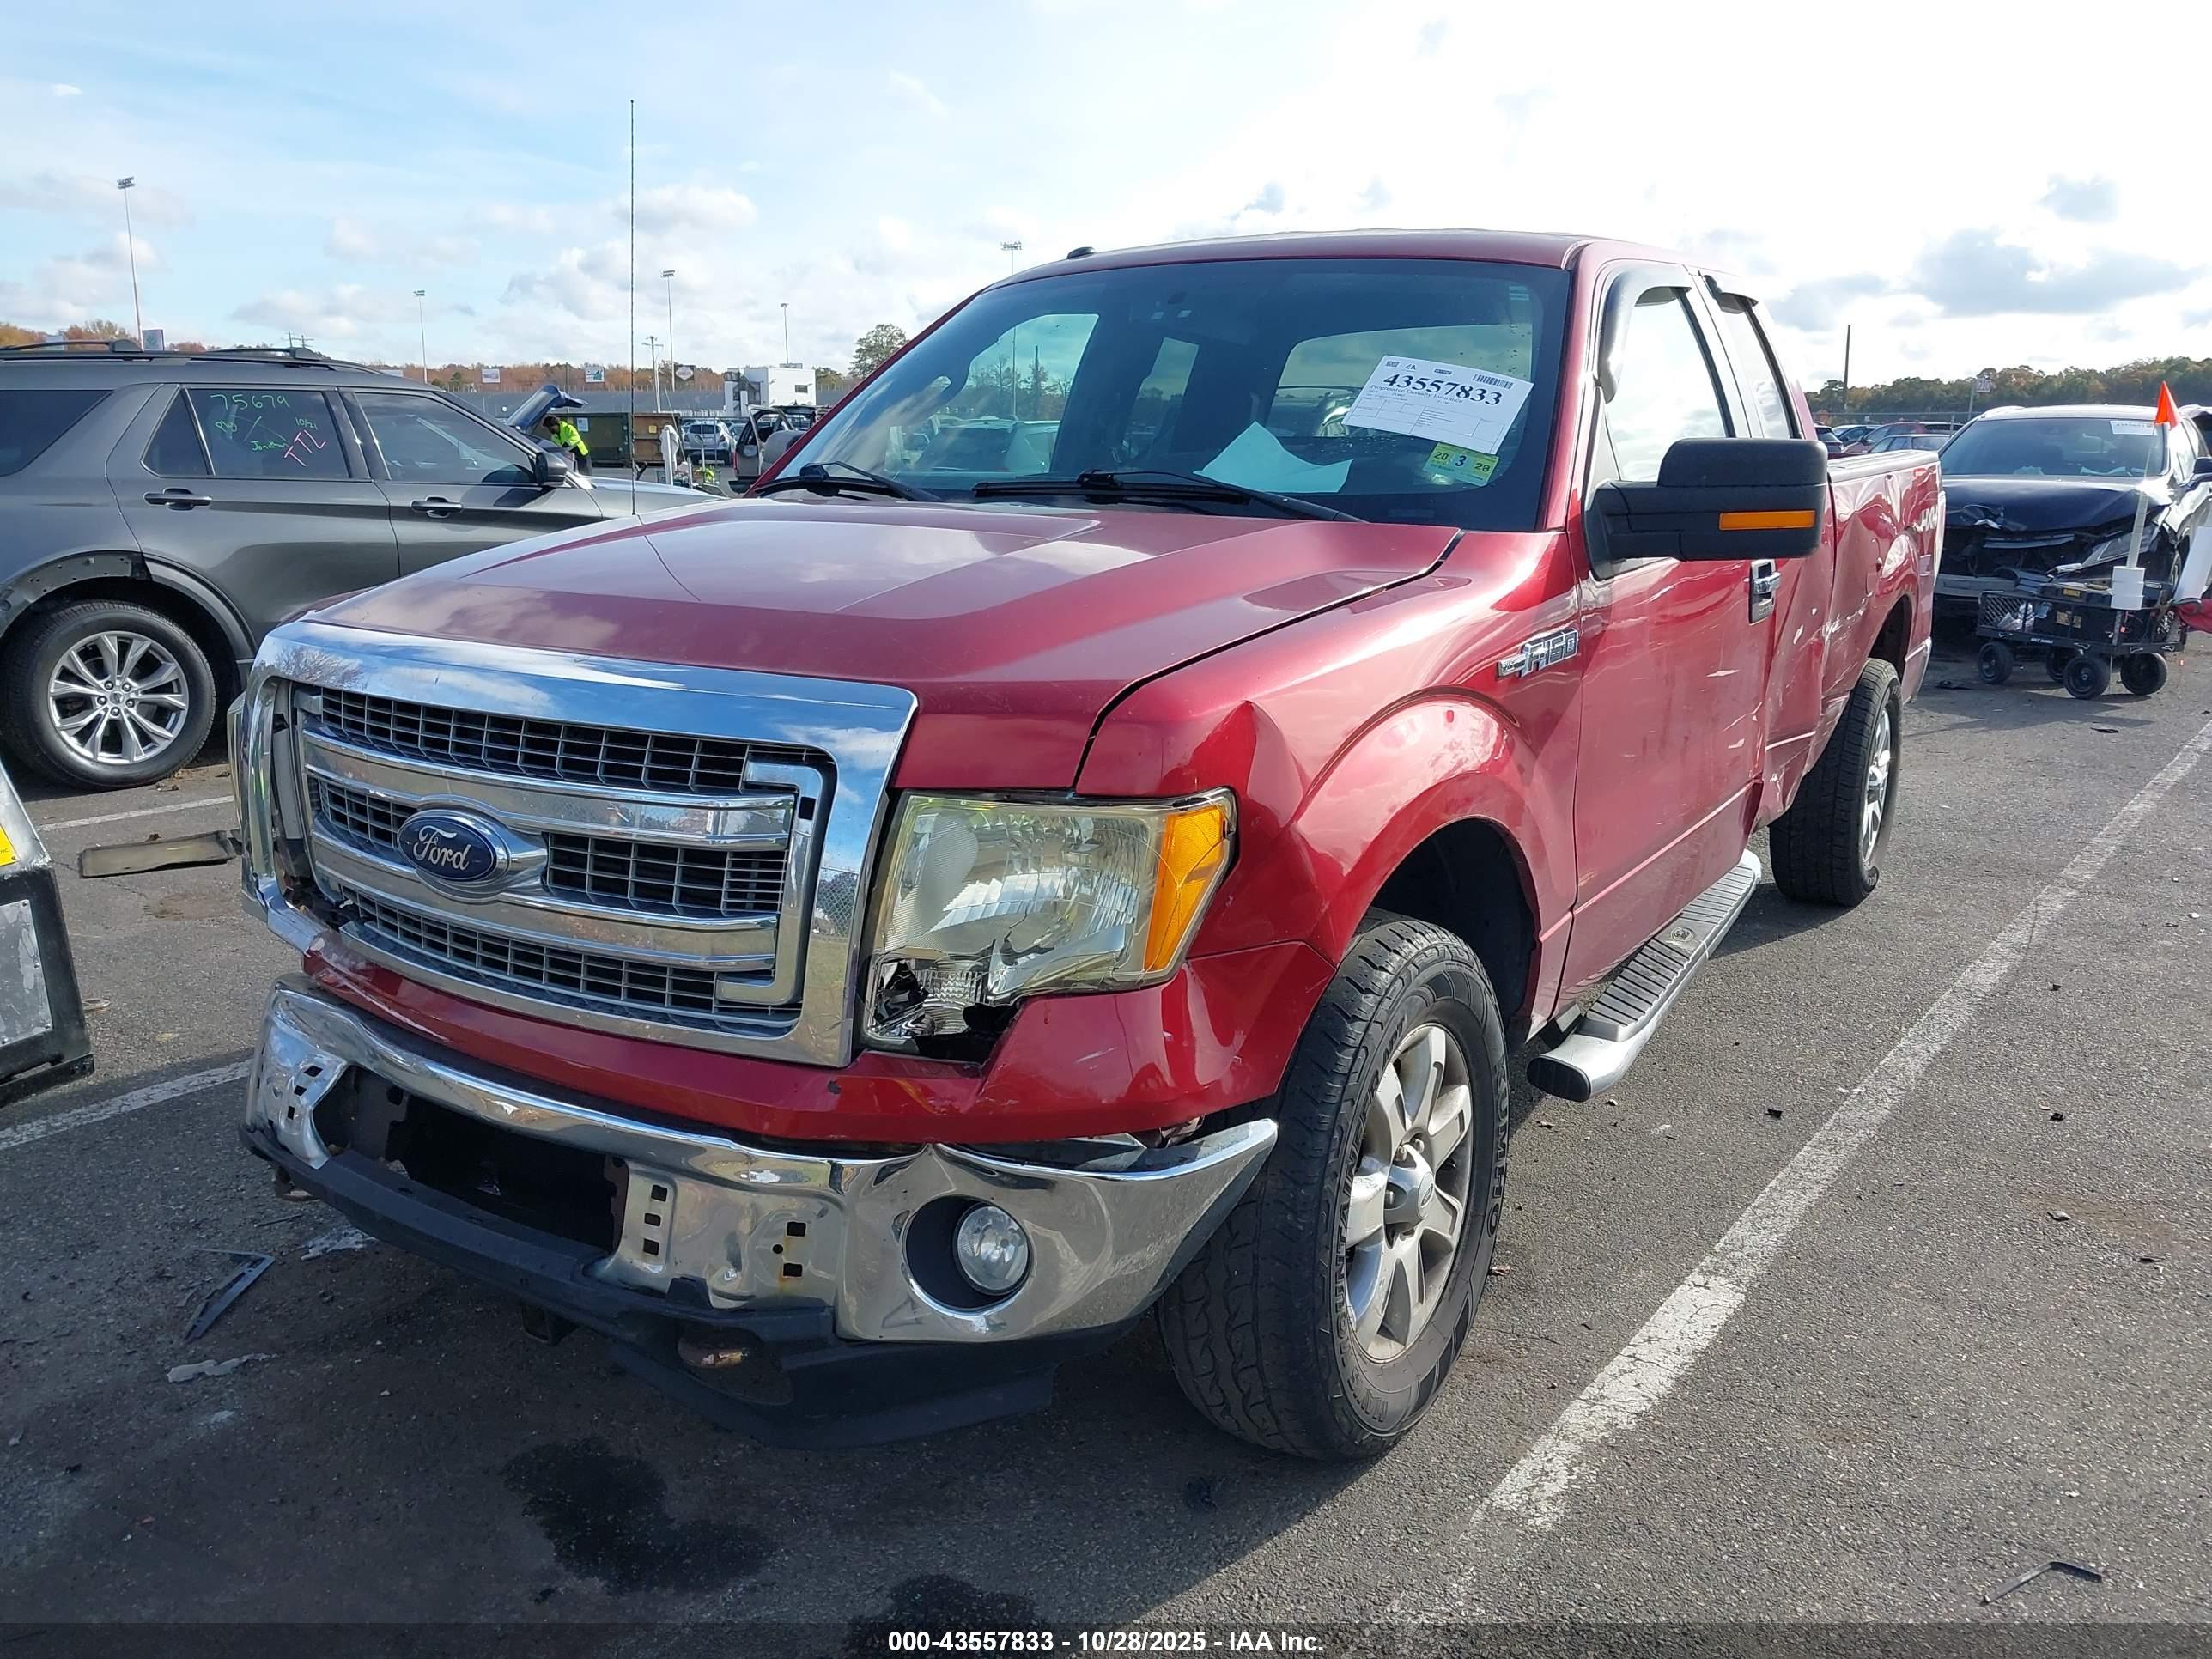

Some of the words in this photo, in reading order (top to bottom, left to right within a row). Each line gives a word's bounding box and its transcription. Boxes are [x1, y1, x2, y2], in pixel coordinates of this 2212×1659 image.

[1383, 374, 1503, 405] 43557833
[1433, 451, 1449, 461] 20
[1455, 454, 1467, 467] 3
[1474, 462, 1491, 473] 28
[413, 825, 471, 871] Ford
[1486, 1060, 1509, 1237] KUMHO
